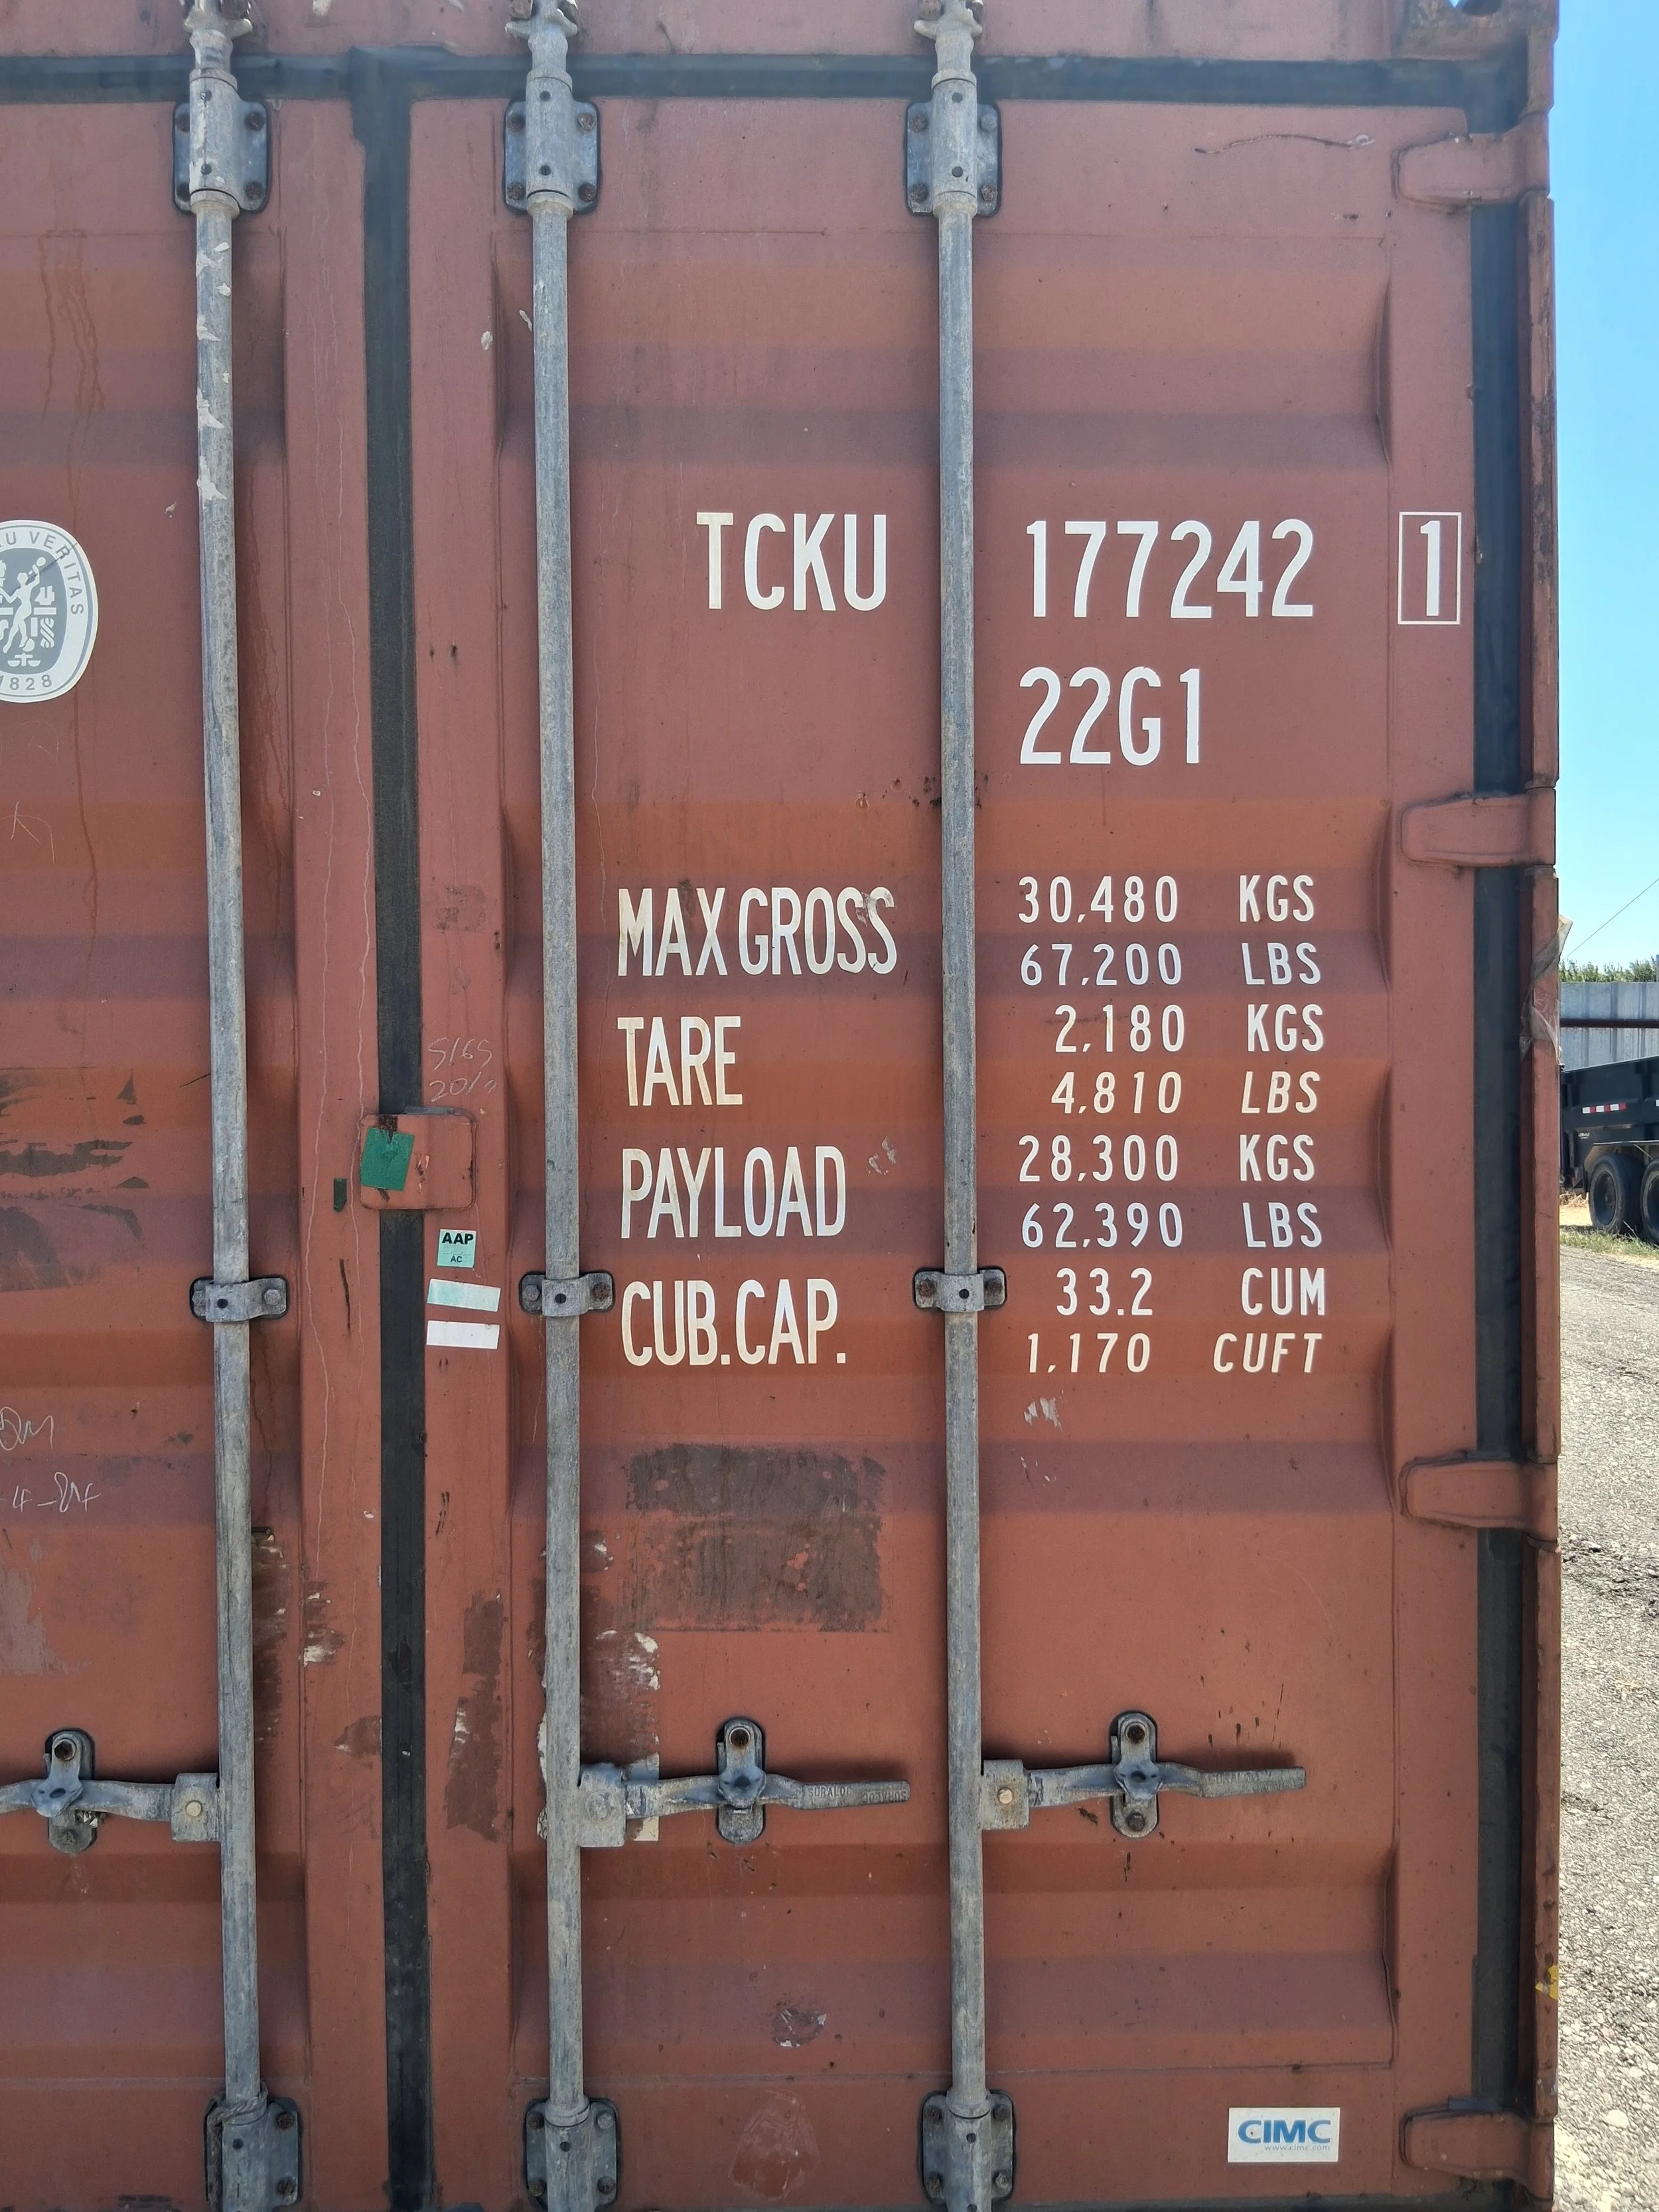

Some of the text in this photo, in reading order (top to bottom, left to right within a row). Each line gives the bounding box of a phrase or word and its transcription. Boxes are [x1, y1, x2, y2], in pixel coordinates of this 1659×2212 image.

[29, 531, 84, 615] VERITAS
[696, 510, 1441, 619] TCKU 177242 1
[1019, 666, 1201, 767] 22G1
[1018, 875, 1315, 924] 30,480 KGS
[618, 886, 898, 977] MAX GROSS
[1021, 942, 1322, 987] 67,200 LBS
[1054, 1003, 1325, 1053] 2,180 KGS
[617, 1015, 743, 1107] TARE
[1051, 1070, 1321, 1115] 4,810 LBS
[1018, 1134, 1316, 1183] 28,300 KGS
[620, 1145, 847, 1240] PAYLOAD
[442, 1232, 474, 1245] AAP
[1022, 1202, 1323, 1249] 62,390 LBS
[1056, 1267, 1326, 1317] 33.2 CUM
[1028, 1332, 1323, 1374] 1,170 CUFT
[1237, 2119, 1332, 2144] CIMC
